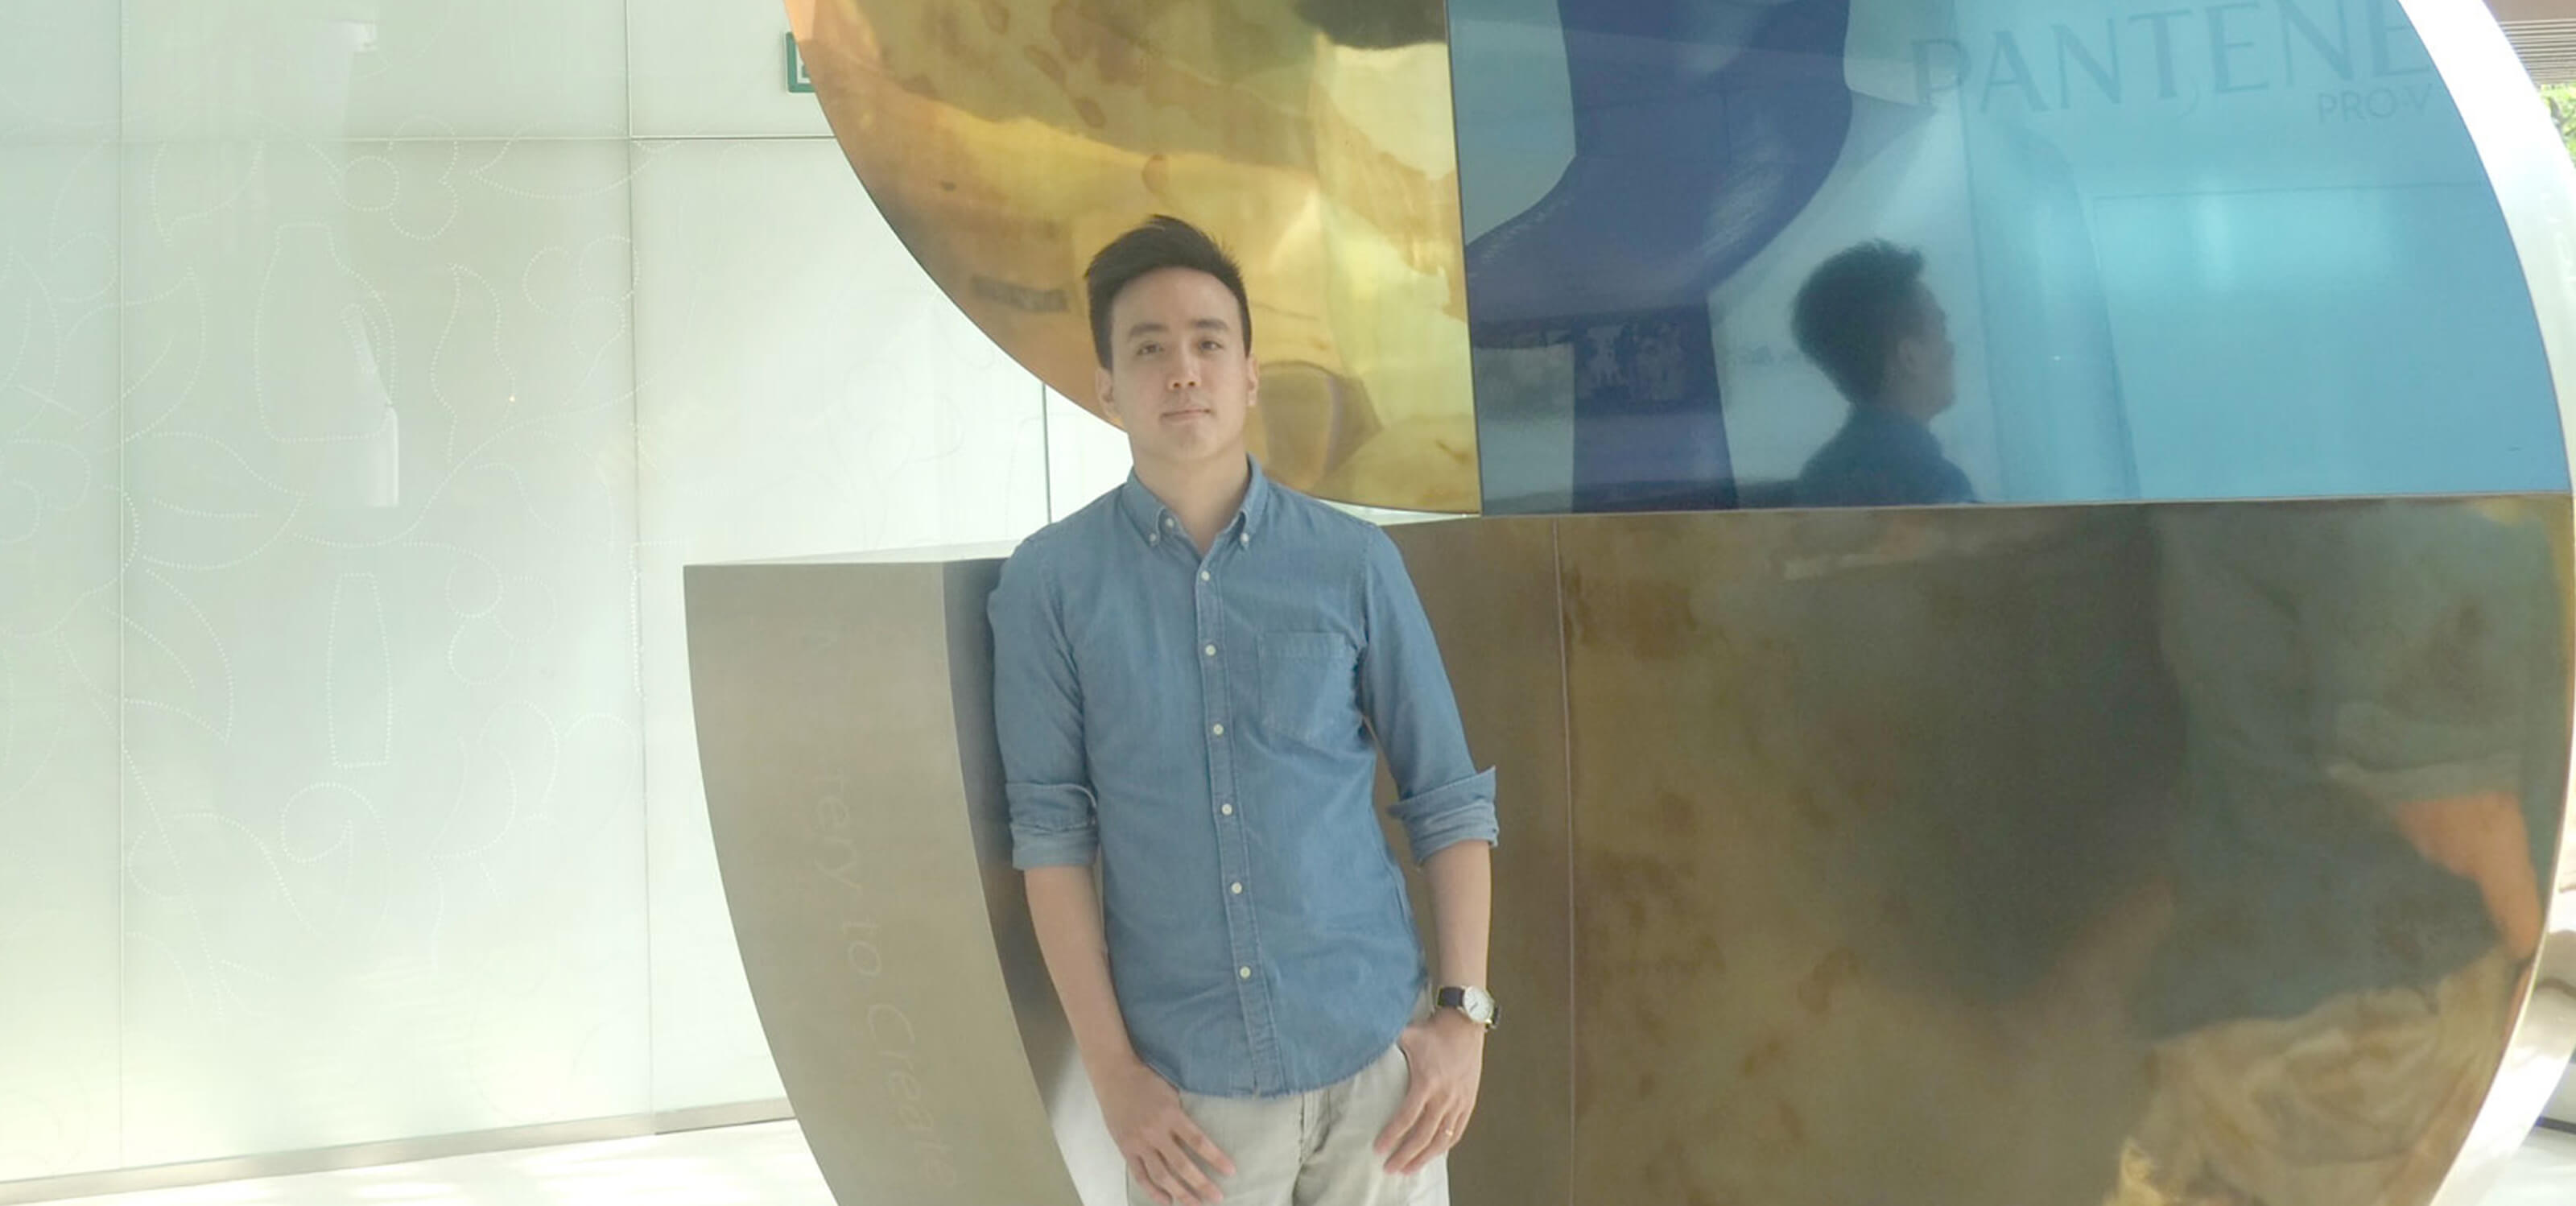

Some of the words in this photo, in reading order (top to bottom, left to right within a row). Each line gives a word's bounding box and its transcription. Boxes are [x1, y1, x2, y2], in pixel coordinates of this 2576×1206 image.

[1910, 0, 2431, 114] PANTENE
[841, 917, 882, 979] to
[865, 1002, 958, 1190] Create
